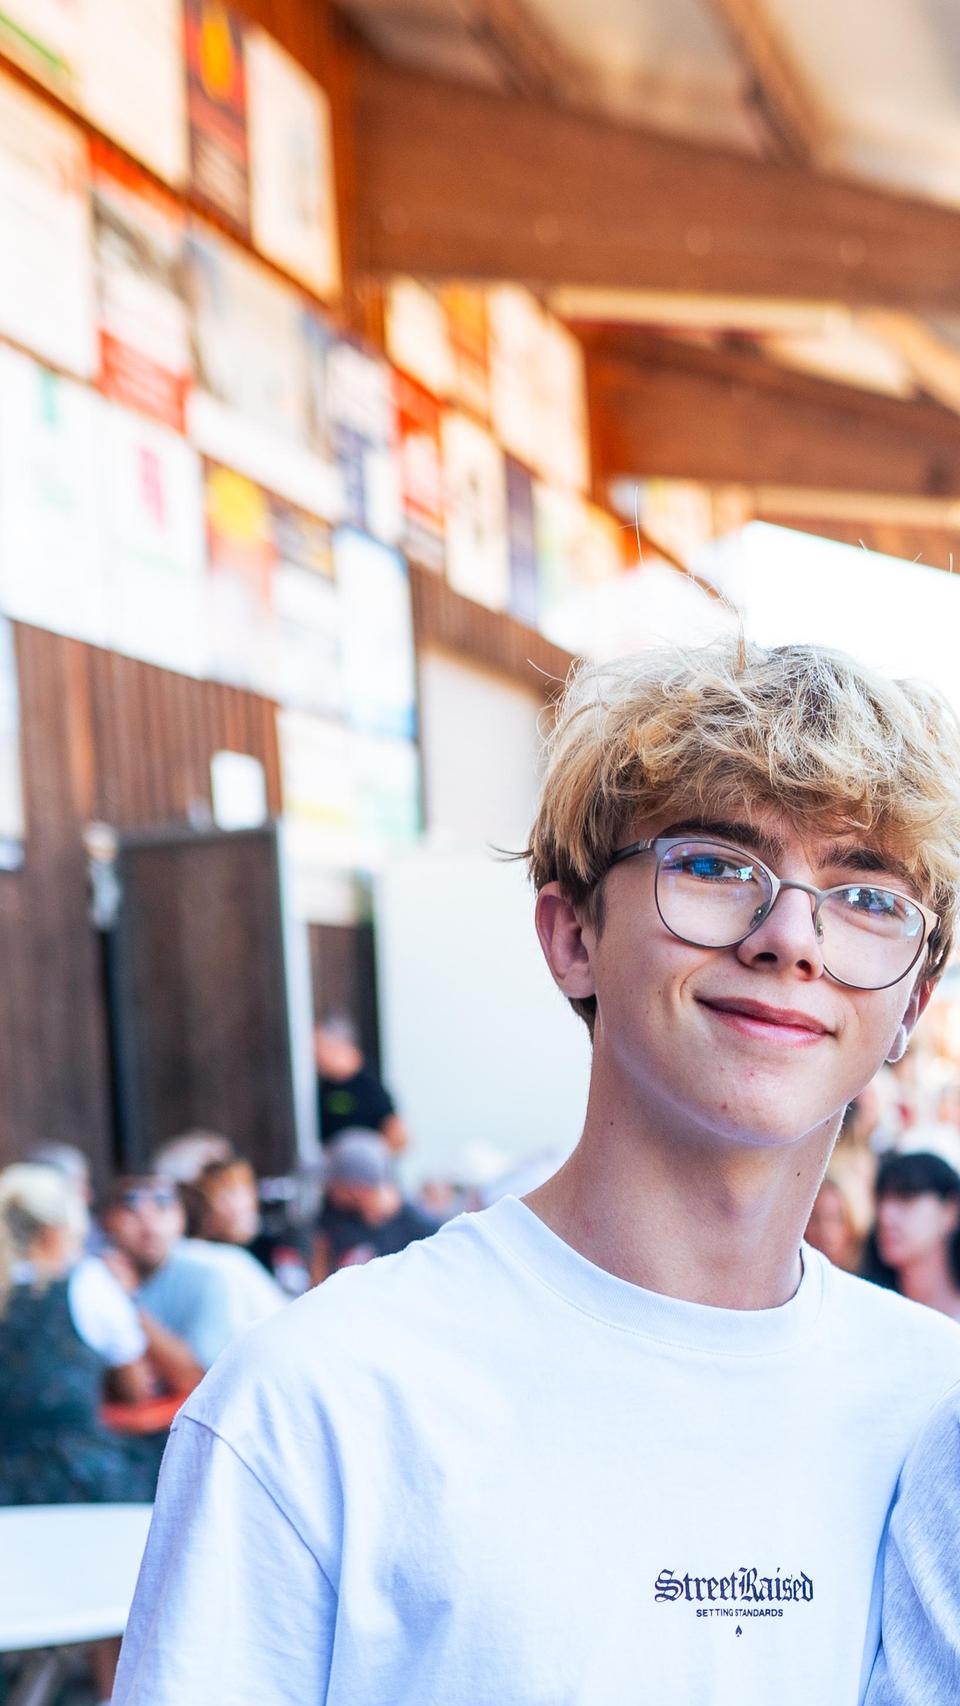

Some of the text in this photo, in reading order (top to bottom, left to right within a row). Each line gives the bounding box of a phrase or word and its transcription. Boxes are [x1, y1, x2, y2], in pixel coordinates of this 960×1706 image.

[655, 1567, 814, 1603] StreetRaised
[696, 1608, 784, 1617] SETTING STANDARDS
